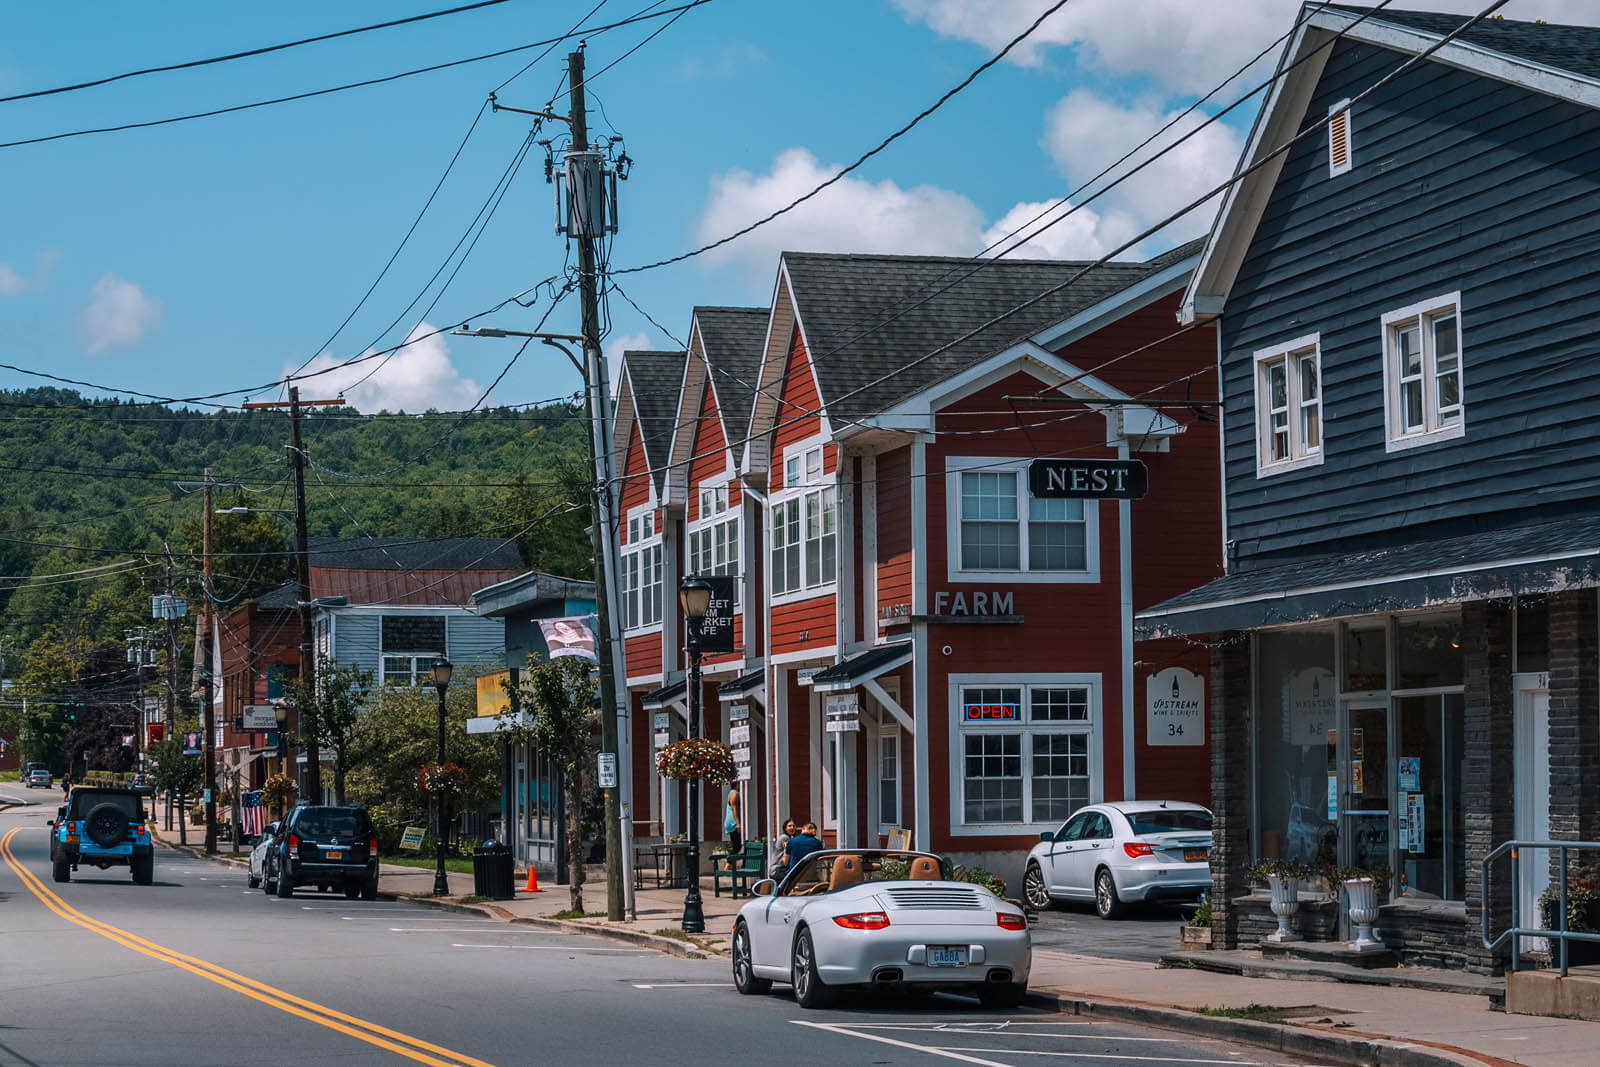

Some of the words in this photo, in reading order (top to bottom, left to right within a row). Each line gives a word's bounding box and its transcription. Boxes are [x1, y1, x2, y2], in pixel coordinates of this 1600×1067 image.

[1046, 467, 1129, 491] NEST
[935, 591, 1014, 616] FARM
[1153, 699, 1199, 709] UPSTREAM
[968, 705, 1013, 718] OPEN
[1167, 723, 1184, 736] 34
